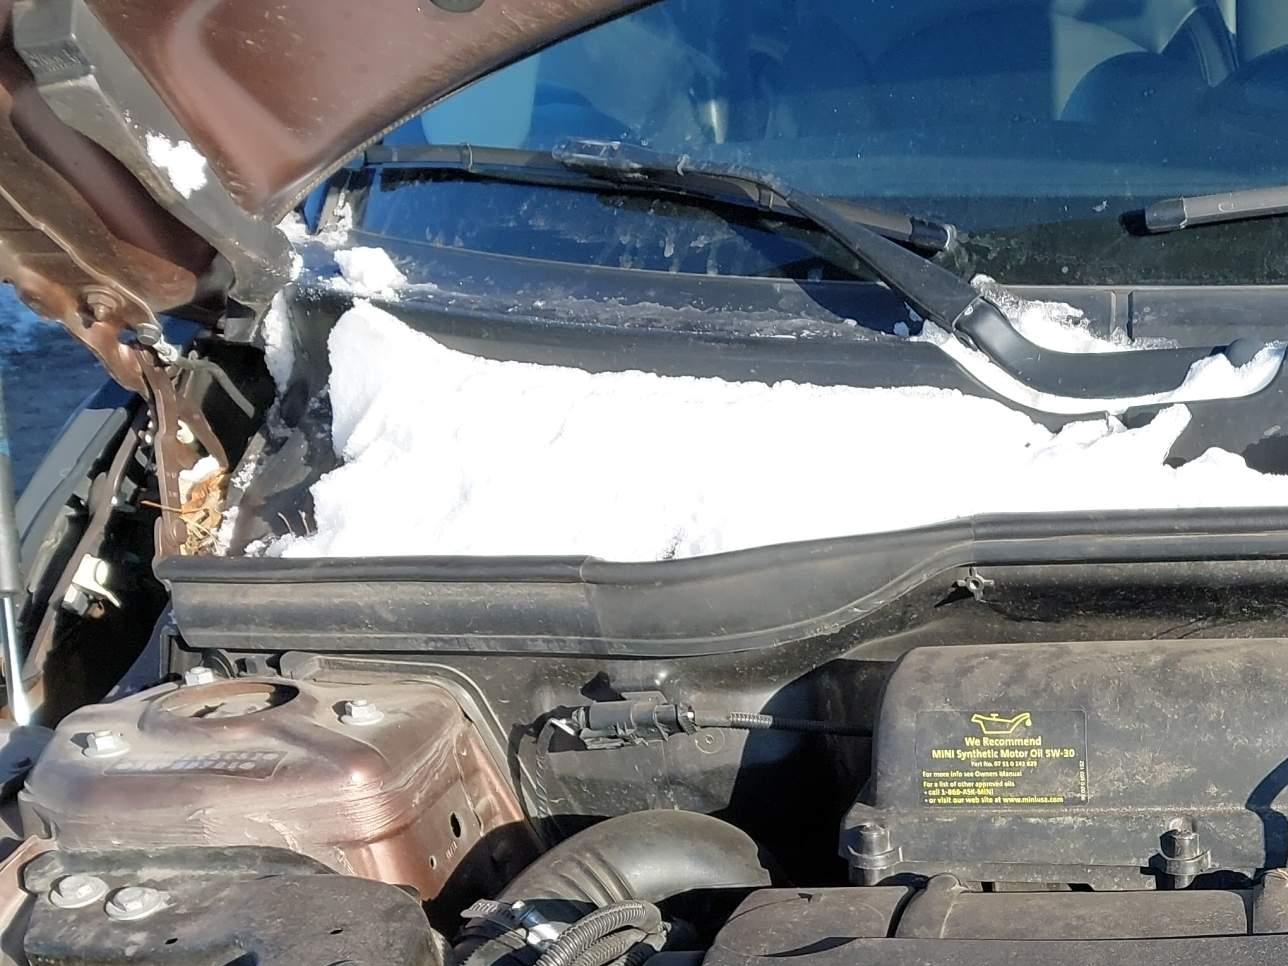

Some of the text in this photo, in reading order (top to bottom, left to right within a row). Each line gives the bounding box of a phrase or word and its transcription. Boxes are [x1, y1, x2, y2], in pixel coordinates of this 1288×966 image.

[964, 736, 1042, 746] We Recommend
[932, 749, 1074, 760] MINI Synthetic Motor Oil 5W-30
